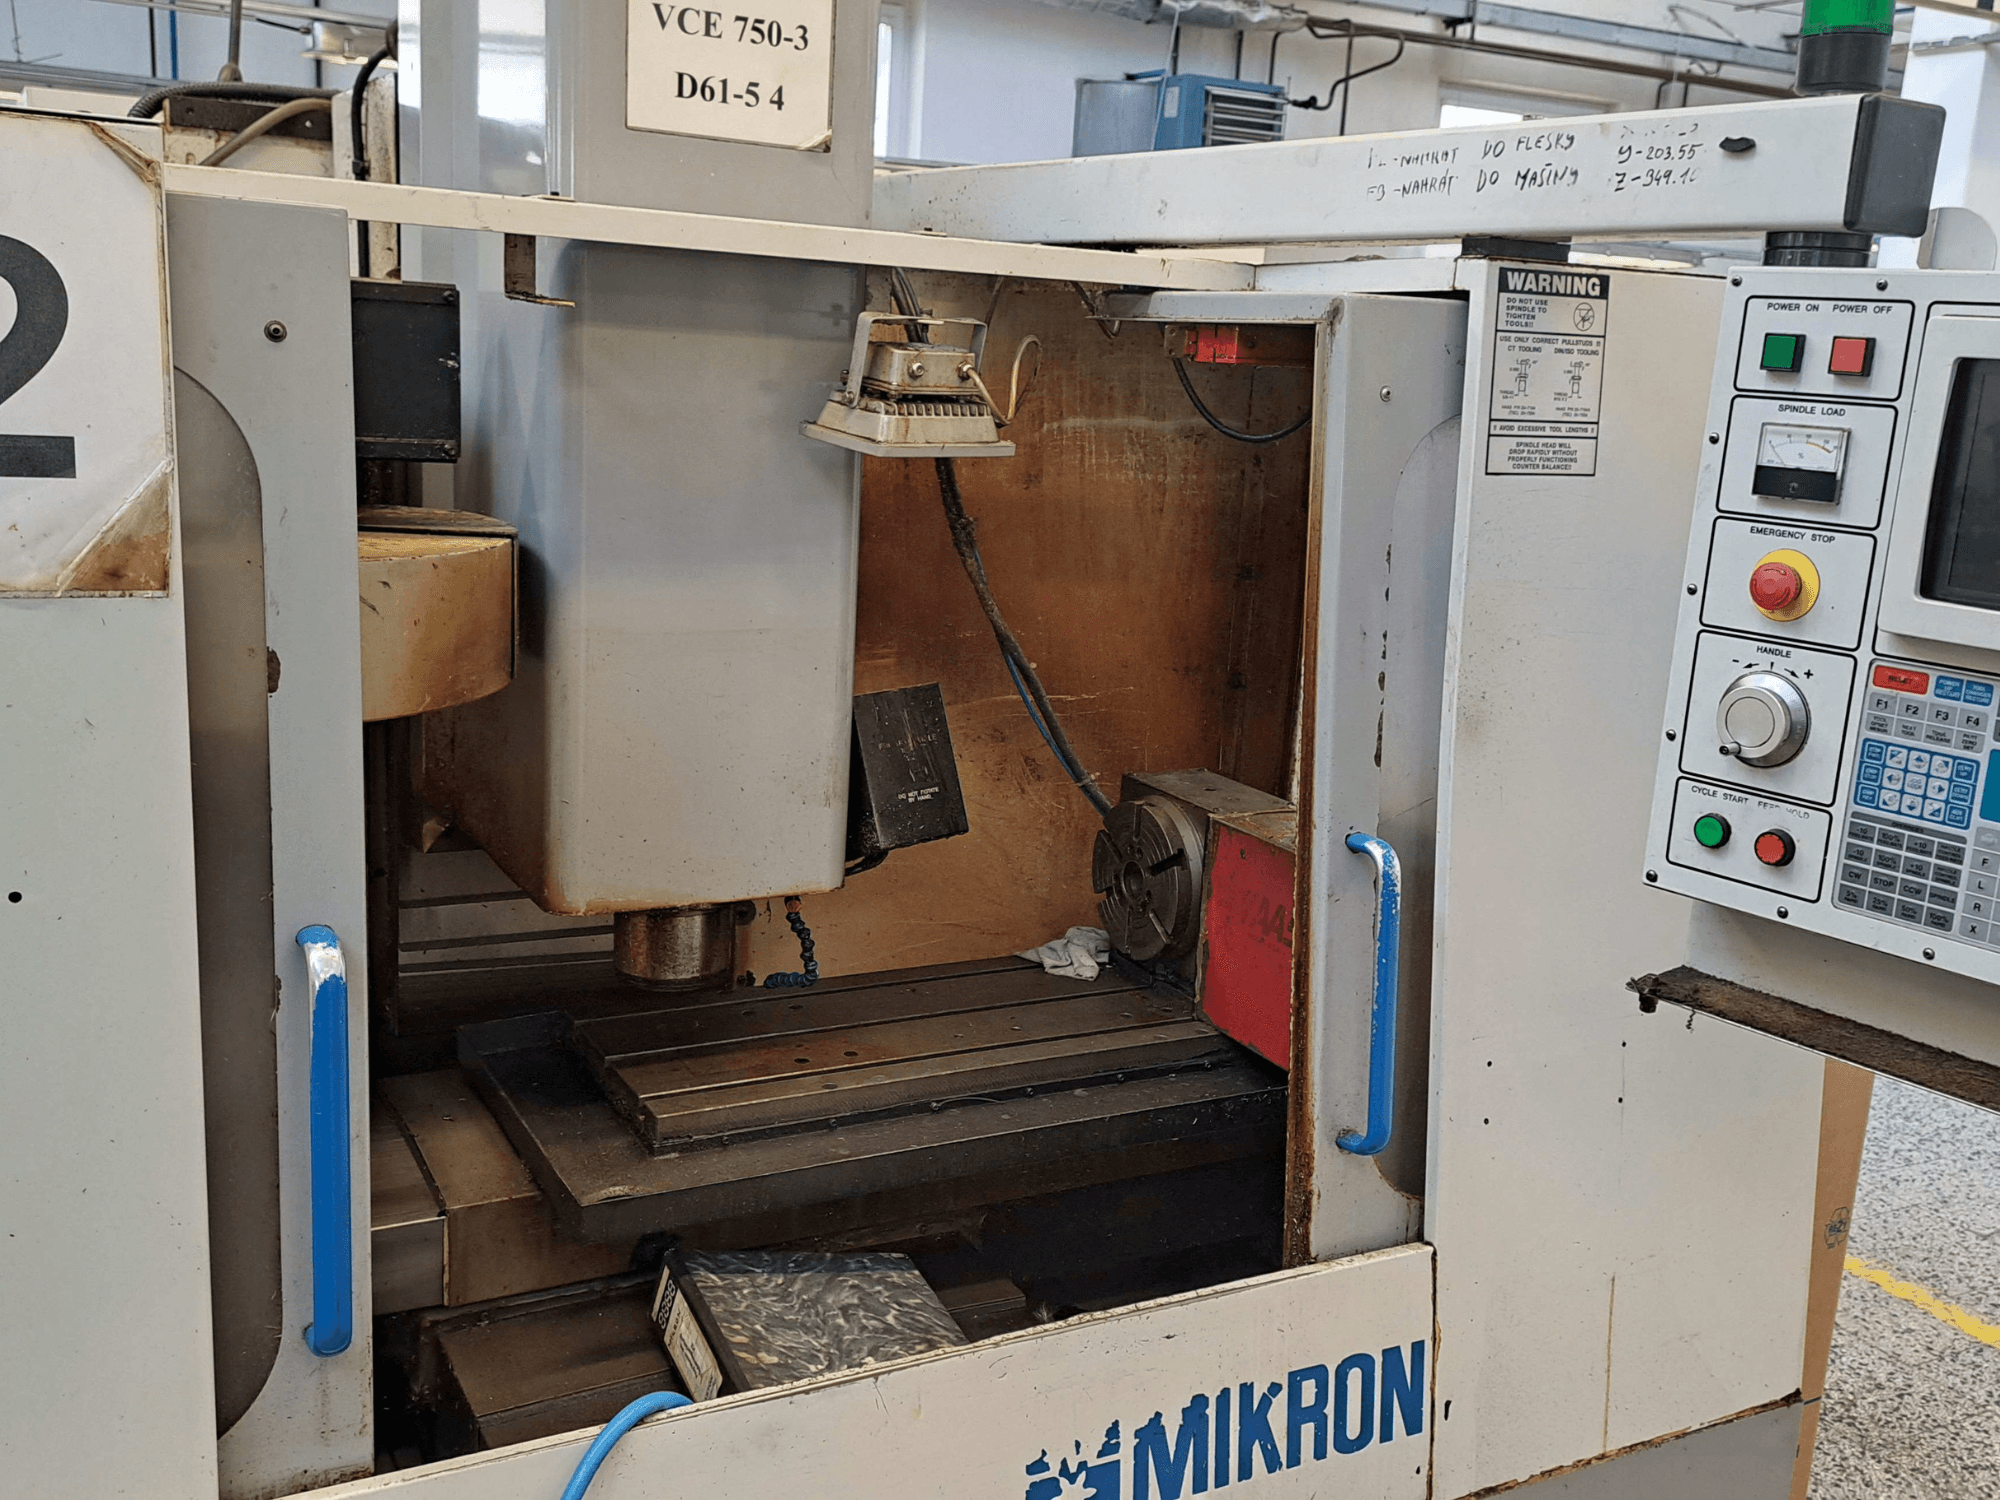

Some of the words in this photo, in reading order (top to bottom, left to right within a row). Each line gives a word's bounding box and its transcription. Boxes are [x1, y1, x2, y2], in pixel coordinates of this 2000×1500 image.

[651, 2, 724, 39] VCE
[733, 15, 809, 51] 750-3
[674, 71, 760, 108] D61-5
[769, 85, 785, 111] 4
[1482, 139, 1506, 159] DO
[1476, 169, 1500, 193] DO
[1507, 271, 1601, 297] WARNING
[1506, 305, 1536, 313] SPINDLE
[1767, 302, 1800, 311] POWER
[1805, 303, 1819, 312] ON
[1832, 304, 1868, 314] POWER
[1873, 305, 1893, 314] OFF
[1506, 312, 1536, 320] TIGHTEN
[1532, 337, 1559, 345] CORRECT
[1562, 339, 1593, 347] PULLSTUDS
[1518, 346, 1542, 354] TOOLING
[1778, 404, 1816, 415] SPINDLE
[1821, 407, 1846, 417] LOAD
[1750, 525, 1806, 540] EMERGENCY
[1811, 533, 1836, 544] STOP
[1756, 645, 1792, 659] HANDLE
[1876, 699, 1888, 709] F1
[1905, 704, 1919, 715] F2
[1935, 710, 1949, 721] F3
[1966, 715, 1980, 726] F4
[1691, 785, 1718, 798] CYCLE
[1722, 793, 1749, 805] START
[1856, 827, 1868, 835] -10
[1853, 849, 1865, 857] -10
[1981, 858, 1989, 866] F
[1848, 871, 1862, 879] CW
[1873, 877, 1894, 887] STOP
[1977, 880, 1984, 890] L
[1903, 885, 1923, 895] CCW
[1973, 902, 1981, 912] R
[1969, 924, 1977, 934] X
[1133, 1339, 1425, 1500] MIKRON
